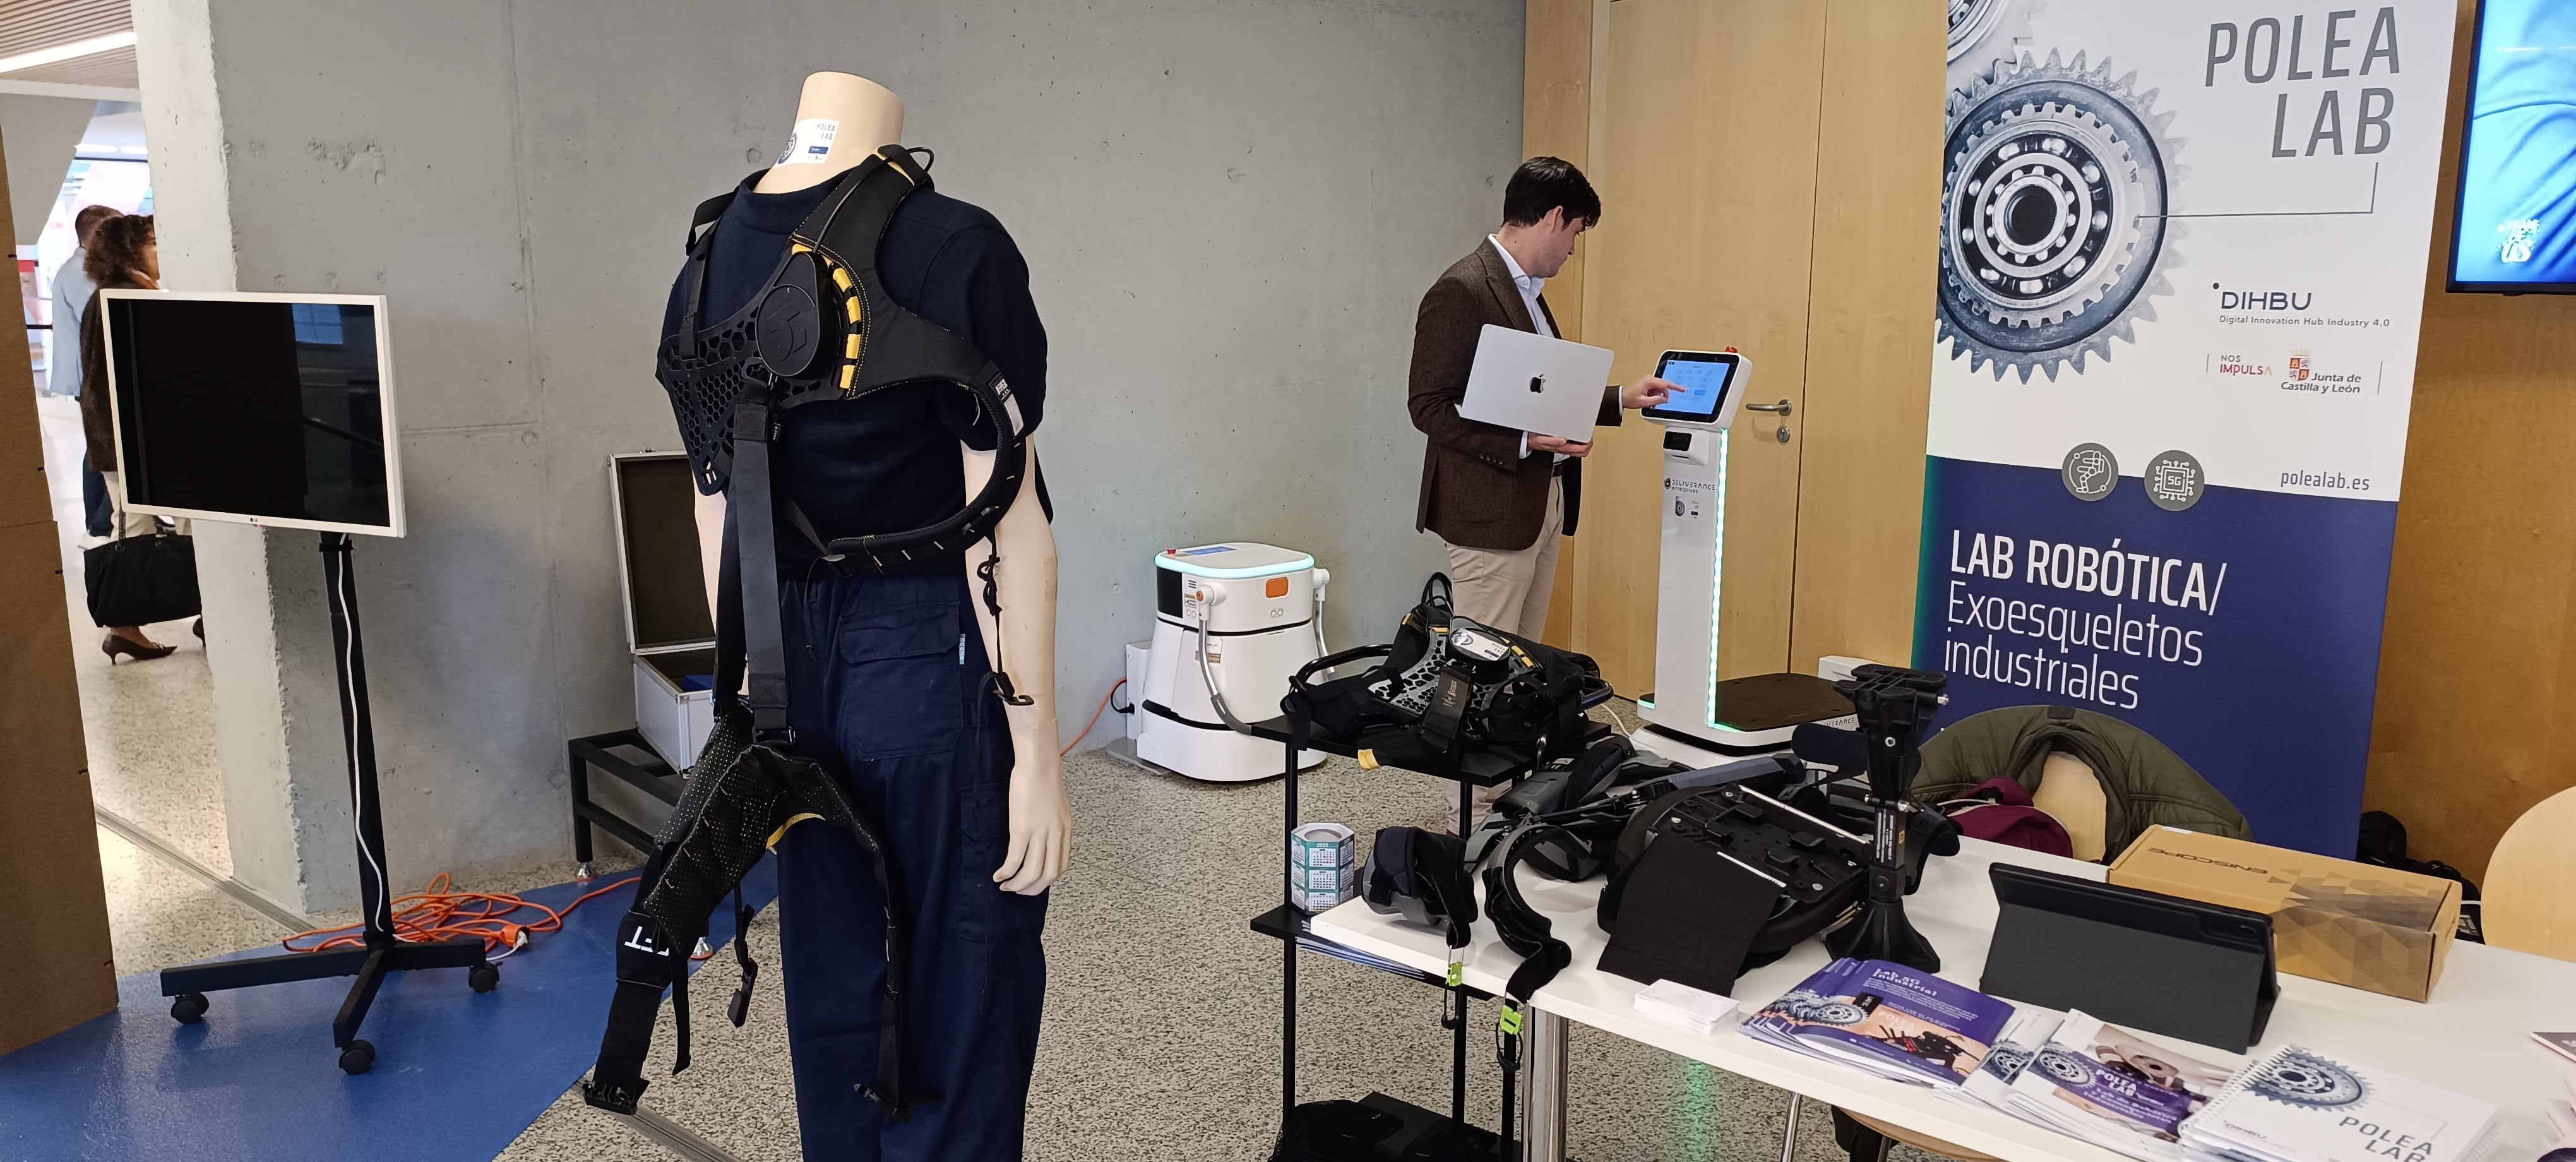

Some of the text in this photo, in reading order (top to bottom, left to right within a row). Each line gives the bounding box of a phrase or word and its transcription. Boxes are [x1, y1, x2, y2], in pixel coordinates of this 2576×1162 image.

[2205, 6, 2400, 87] POLEA
[2272, 87, 2394, 158] LAB
[2221, 291, 2312, 311] DIHBU
[2219, 315, 2390, 328] Digital Innovation Hub Industry 4.0
[2221, 355, 2241, 363] NOS
[2281, 381, 2361, 395] Castilla y León
[2311, 373, 2362, 383] Junta de
[2281, 469, 2370, 491] polealab.es
[1951, 529, 2015, 580] LAB
[1948, 580, 2204, 667] Exoesqueletos
[1945, 626, 2139, 709] industriales
[2096, 1069, 2137, 1090] POLEA
[2339, 1117, 2433, 1155] POLEA
